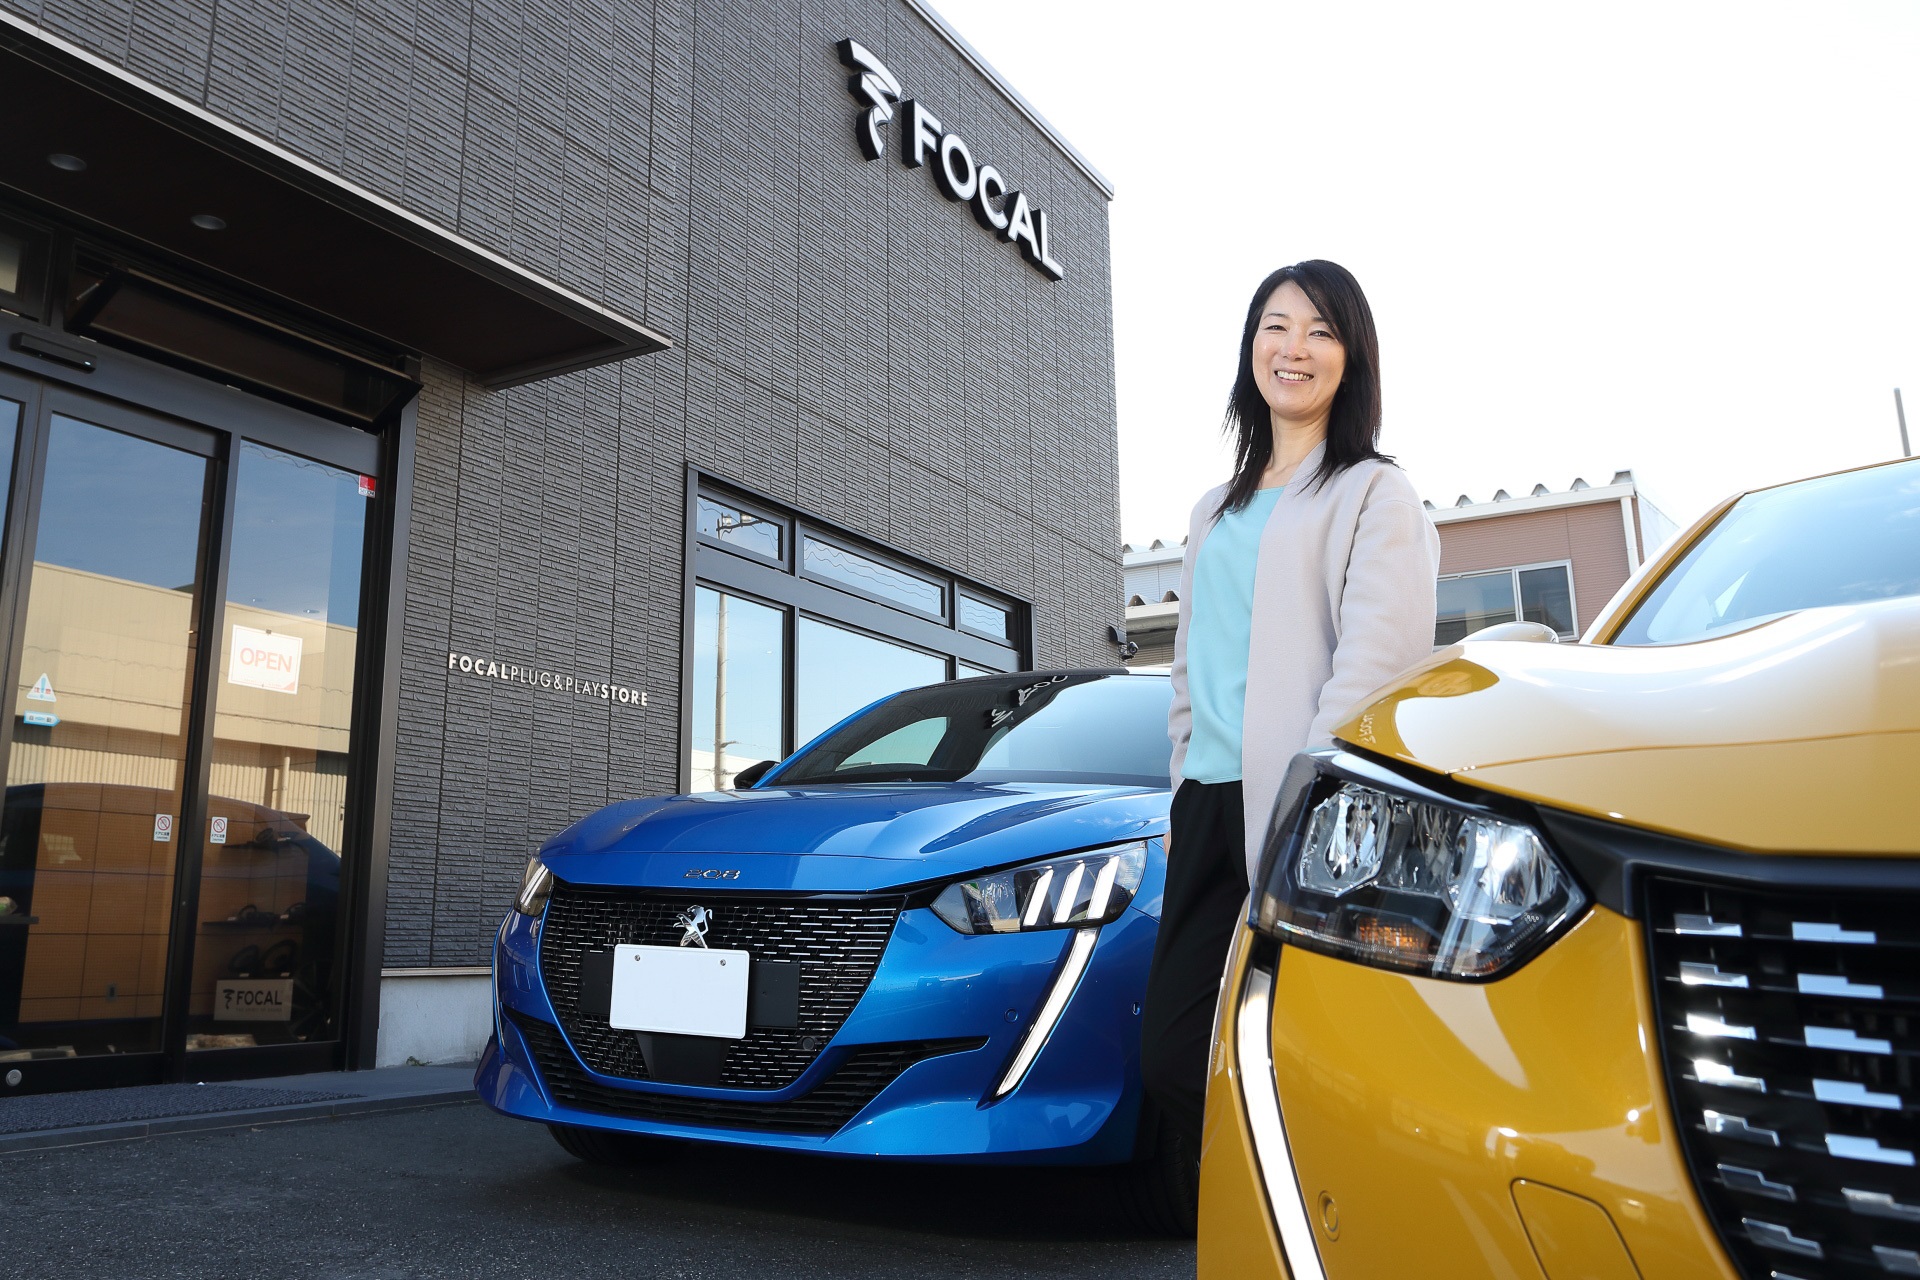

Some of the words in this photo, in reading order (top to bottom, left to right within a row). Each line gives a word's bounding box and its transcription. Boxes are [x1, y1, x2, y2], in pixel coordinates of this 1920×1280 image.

[902, 99, 1064, 282] FOCAL
[240, 647, 293, 673] OPEN
[683, 869, 741, 880] 208
[236, 990, 283, 1006] FOCAL
